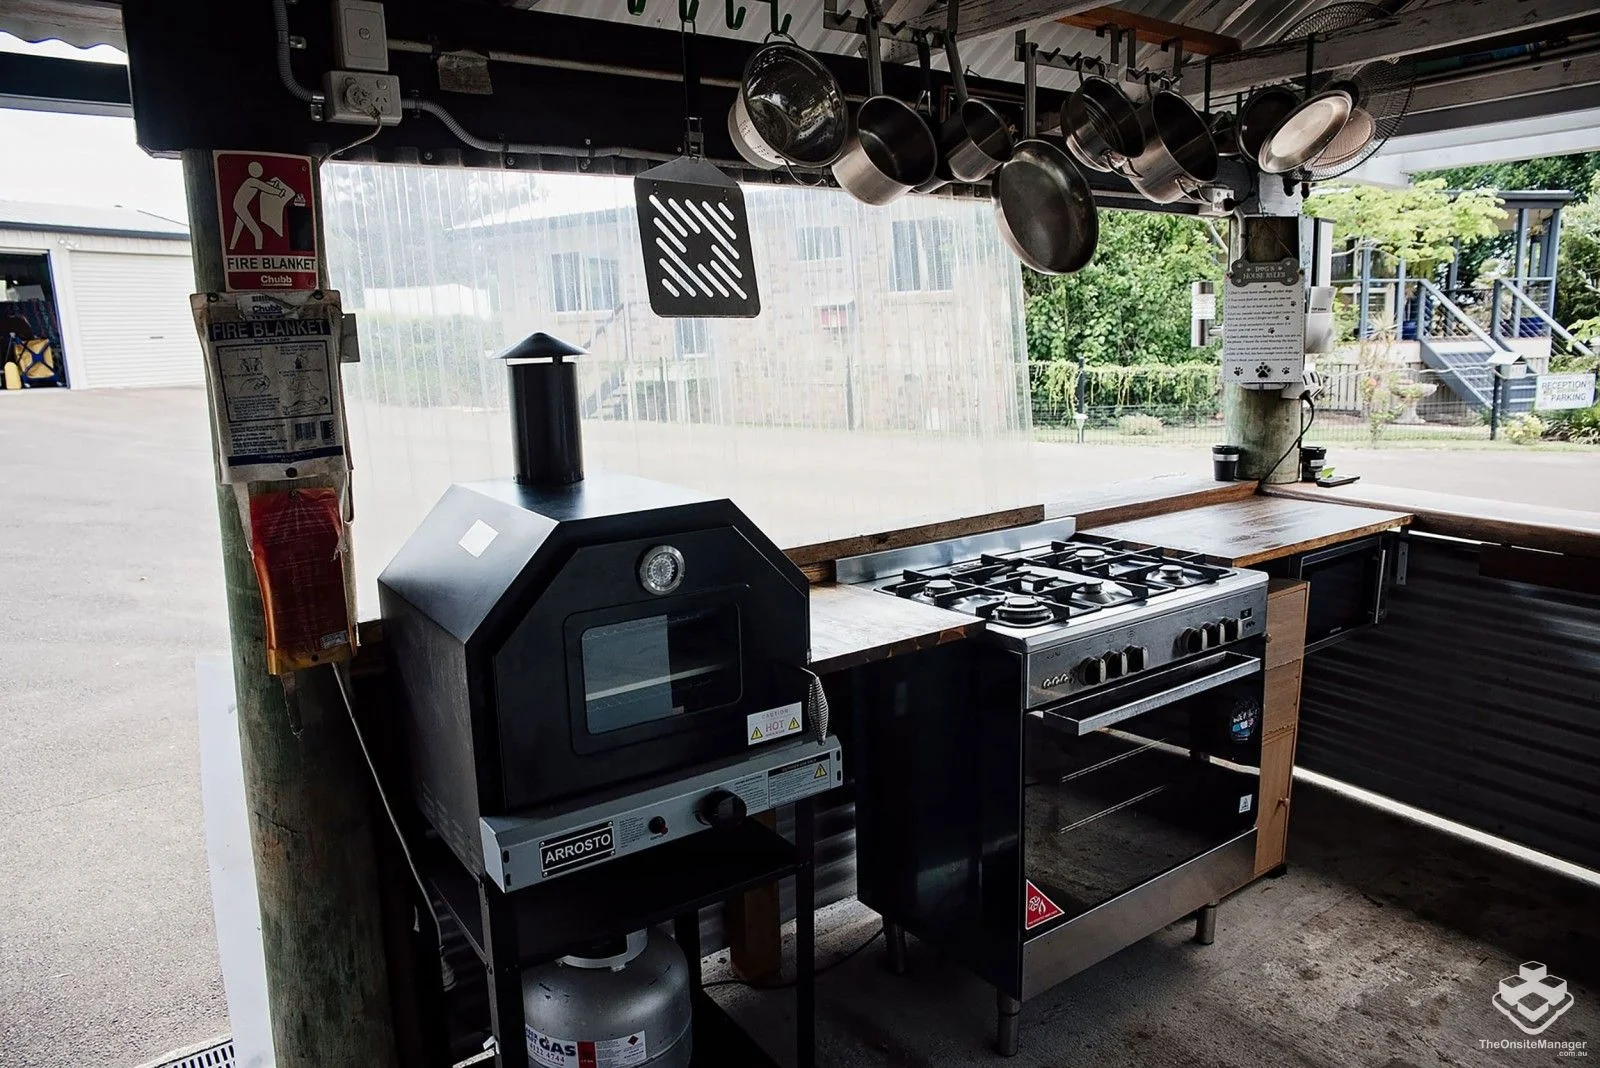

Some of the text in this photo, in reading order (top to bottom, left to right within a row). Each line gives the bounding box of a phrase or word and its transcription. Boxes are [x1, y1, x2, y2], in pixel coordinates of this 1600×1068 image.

[227, 257, 316, 270] FIRE BLANKET
[260, 275, 293, 284] Chubb
[252, 304, 283, 312] Chubb
[212, 320, 325, 340] FIRE BLANKET
[1542, 380, 1587, 390] RECEPTION
[1551, 393, 1586, 401] PARKING
[761, 708, 789, 719] CAUTION
[765, 719, 784, 732] HOT
[545, 834, 611, 864] ARROSTO
[539, 1037, 577, 1056] GAS
